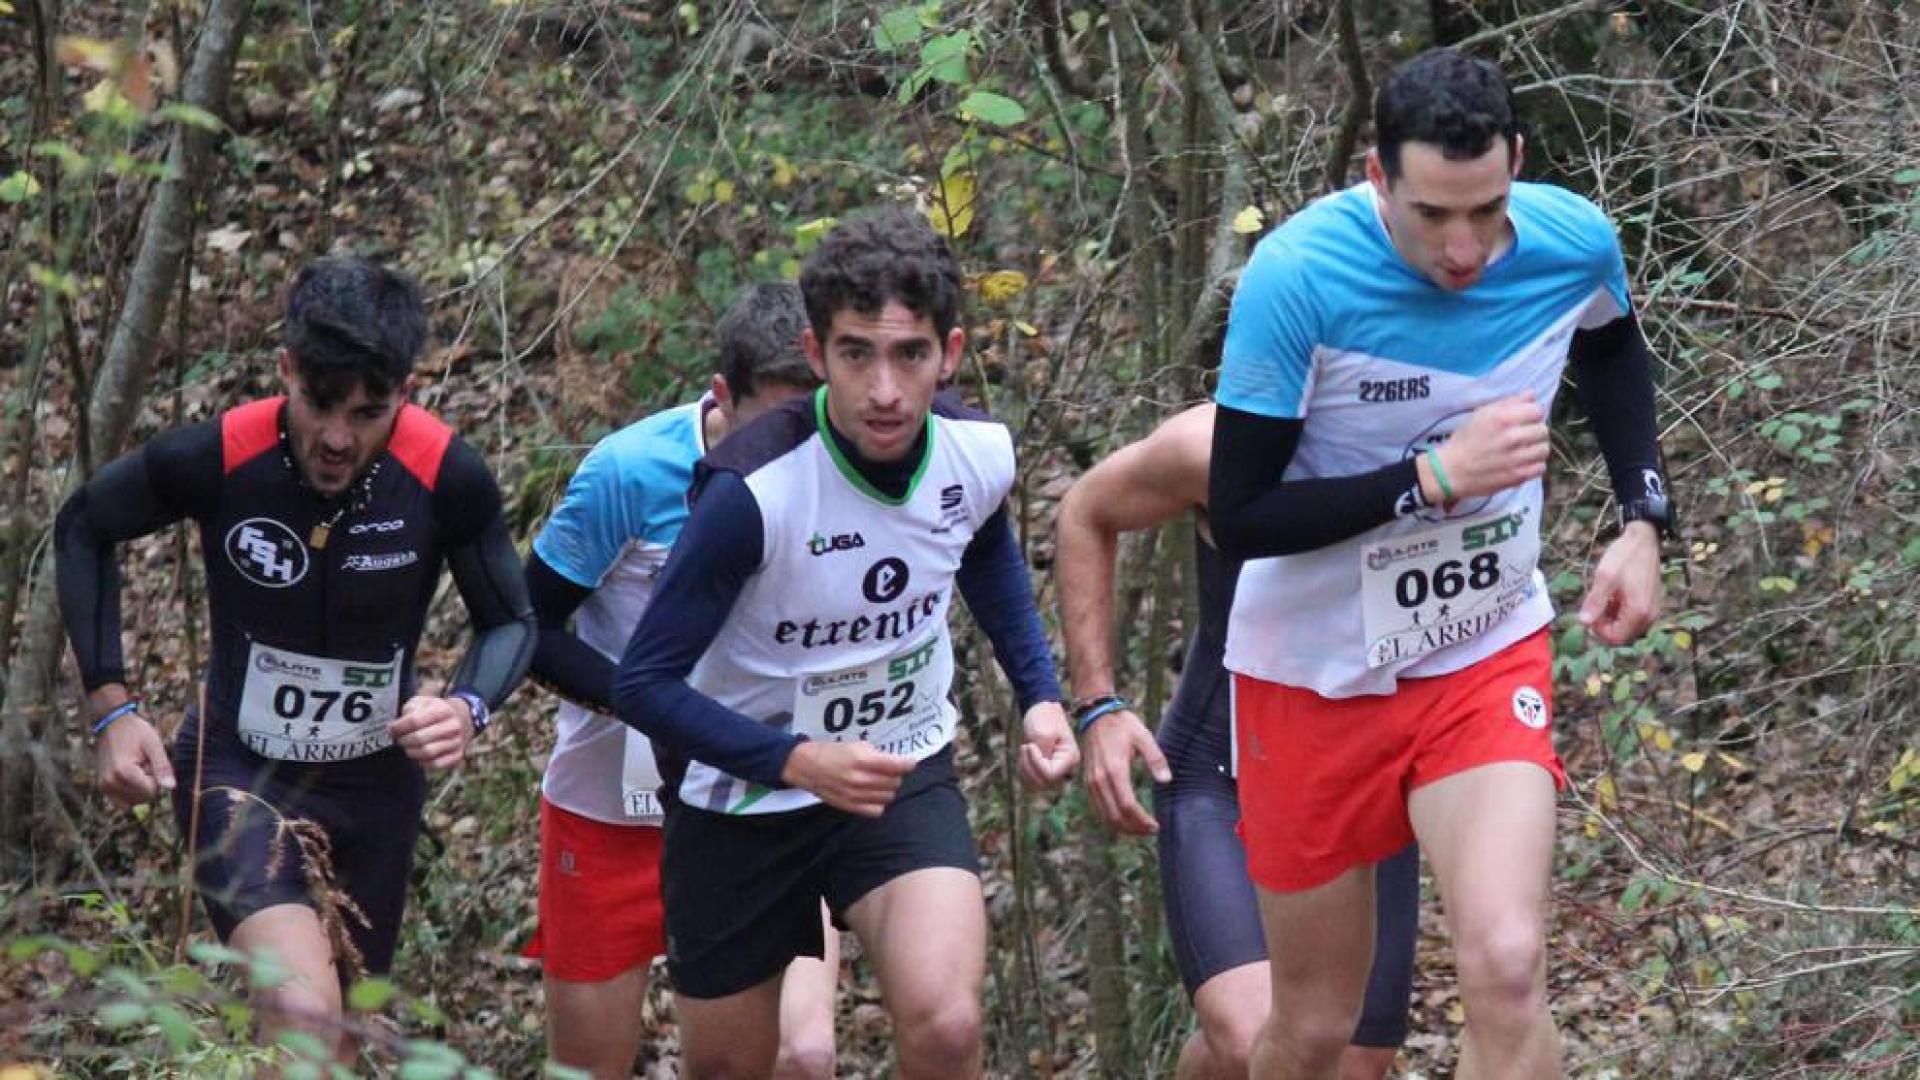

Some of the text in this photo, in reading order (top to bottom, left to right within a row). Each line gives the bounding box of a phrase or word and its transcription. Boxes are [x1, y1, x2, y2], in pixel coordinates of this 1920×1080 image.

[1360, 374, 1430, 403] 226ERS
[238, 526, 293, 581] FSH
[1396, 552, 1500, 608] 068
[1378, 636, 1408, 664] EL
[274, 684, 374, 724] 076
[823, 681, 915, 734] 052
[247, 734, 274, 758] EL
